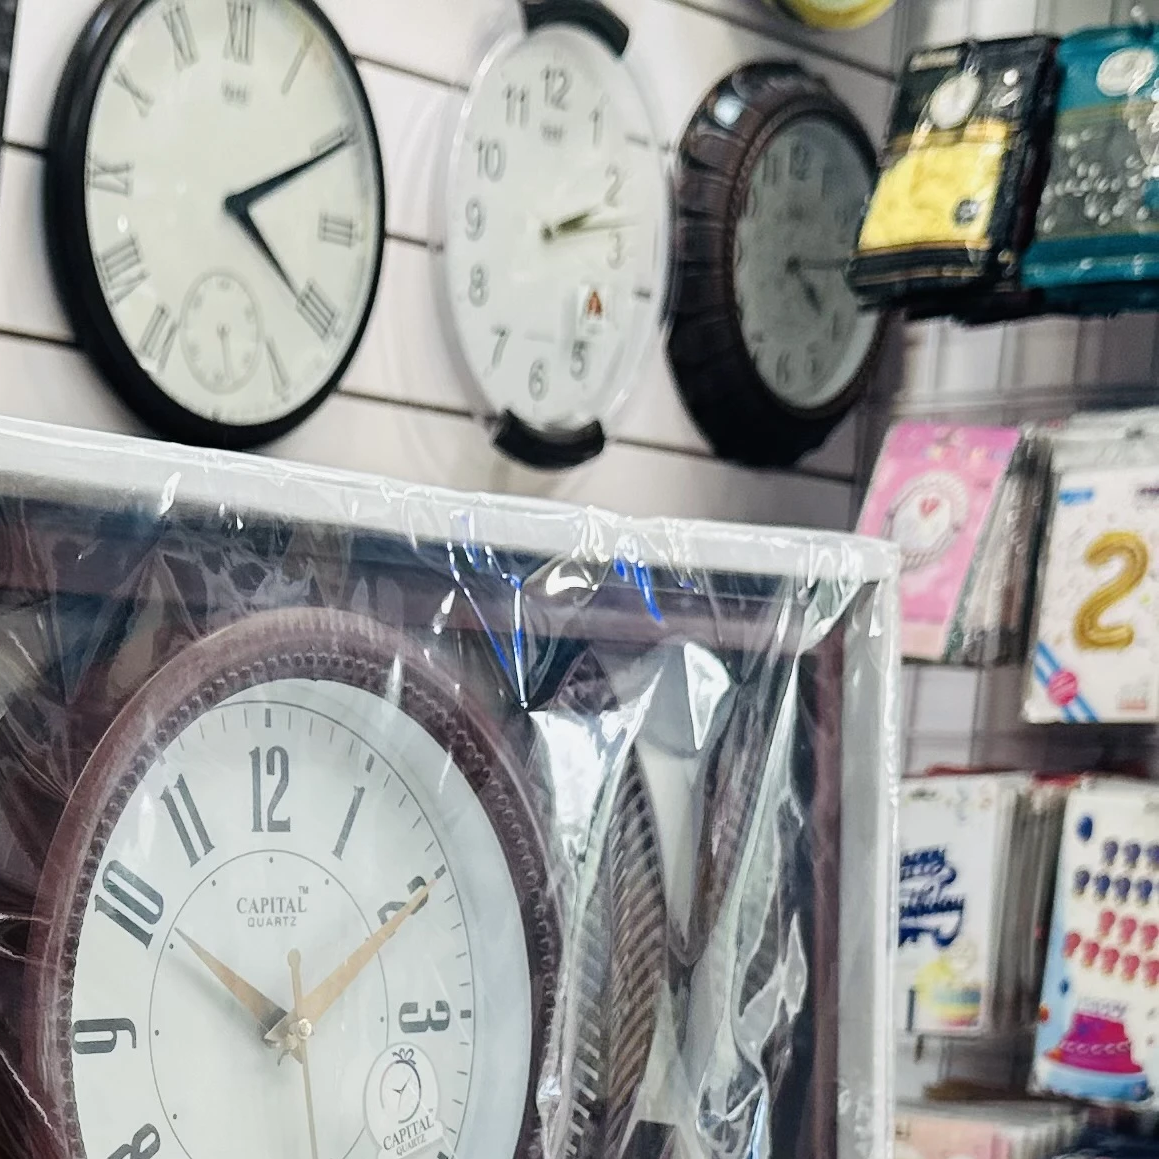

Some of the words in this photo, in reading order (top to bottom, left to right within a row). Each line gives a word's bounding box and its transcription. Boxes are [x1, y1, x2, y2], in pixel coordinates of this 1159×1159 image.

[503, 84, 532, 128] 11
[543, 63, 572, 110] 12
[475, 140, 506, 182] 10
[464, 199, 486, 242] 9
[468, 266, 489, 308] 8
[491, 326, 511, 371] 7
[569, 340, 589, 381] 5
[528, 359, 548, 401] 6
[1073, 531, 1149, 651] 2
[248, 745, 291, 833] 12
[160, 773, 215, 867] 11
[331, 786, 366, 860] 1
[93, 860, 164, 949] 10
[236, 896, 307, 914] CAPITAL
[247, 916, 297, 928] QUARTZ
[73, 1018, 137, 1055] 9
[398, 1000, 450, 1034] 3
[383, 1115, 434, 1151] CAPITAL
[396, 1134, 426, 1156] QUARTZ
